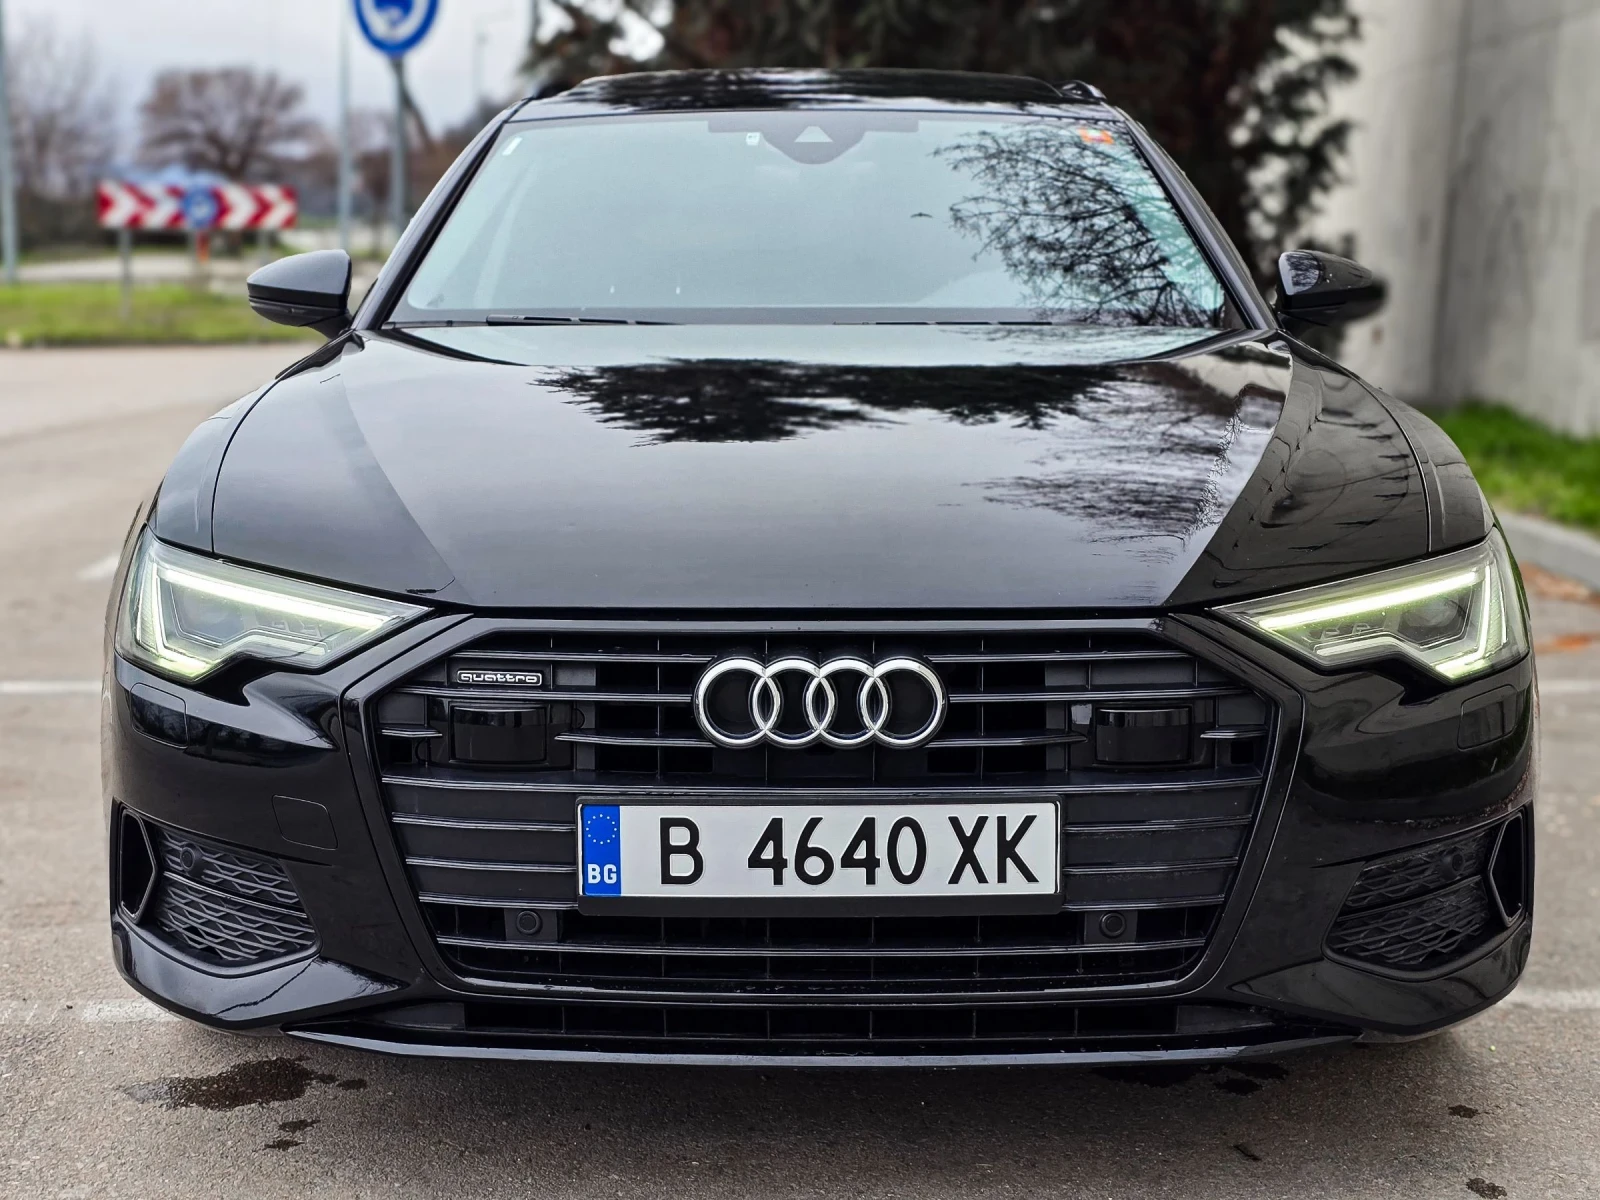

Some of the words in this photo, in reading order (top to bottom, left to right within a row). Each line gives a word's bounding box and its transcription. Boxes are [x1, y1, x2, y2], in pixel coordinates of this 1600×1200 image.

[460, 673, 538, 683] quattro
[659, 816, 704, 886] B
[747, 816, 927, 886] 4640
[947, 814, 1040, 885] XK
[587, 863, 617, 884] BG
